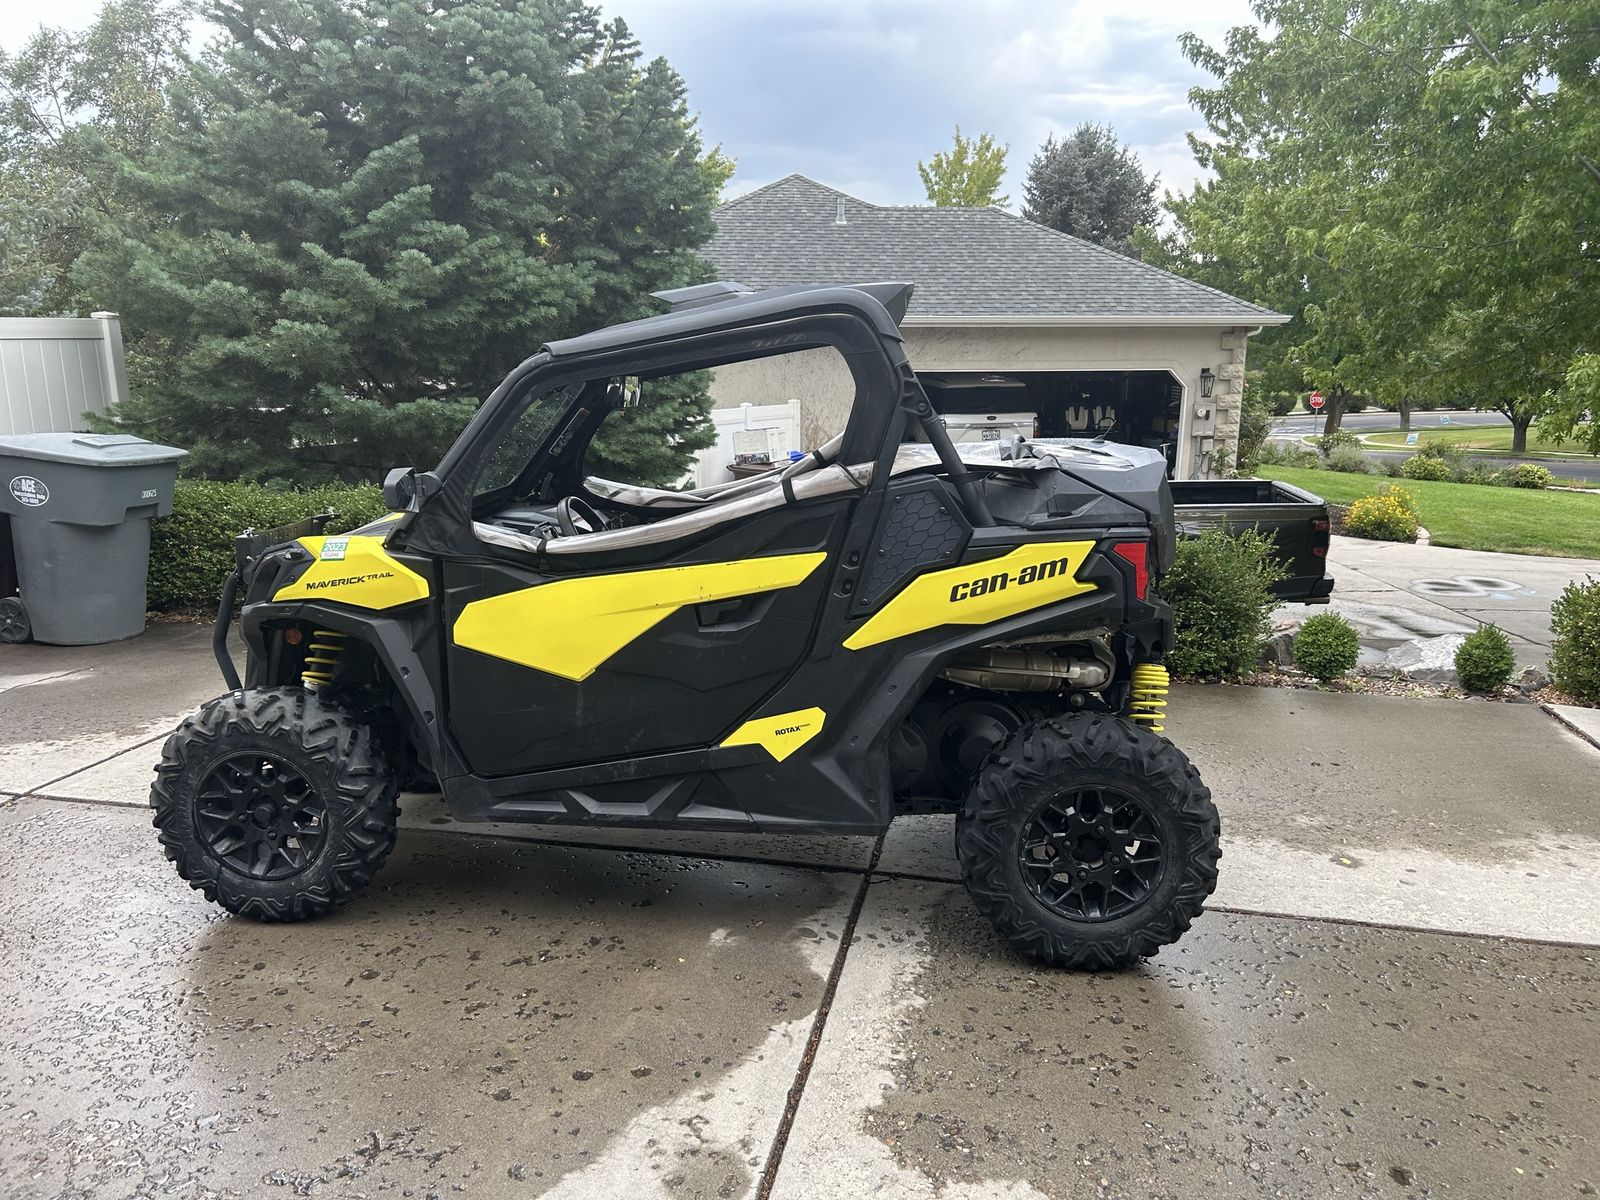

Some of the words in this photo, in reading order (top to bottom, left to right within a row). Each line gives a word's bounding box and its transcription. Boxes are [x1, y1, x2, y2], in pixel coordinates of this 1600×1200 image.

[21, 479, 36, 493] ACE
[323, 543, 346, 551] 2023
[306, 576, 366, 590] MAVERICK
[367, 571, 394, 580] TRAIL
[950, 557, 1068, 602] can-am
[774, 725, 801, 736] ROTAX
